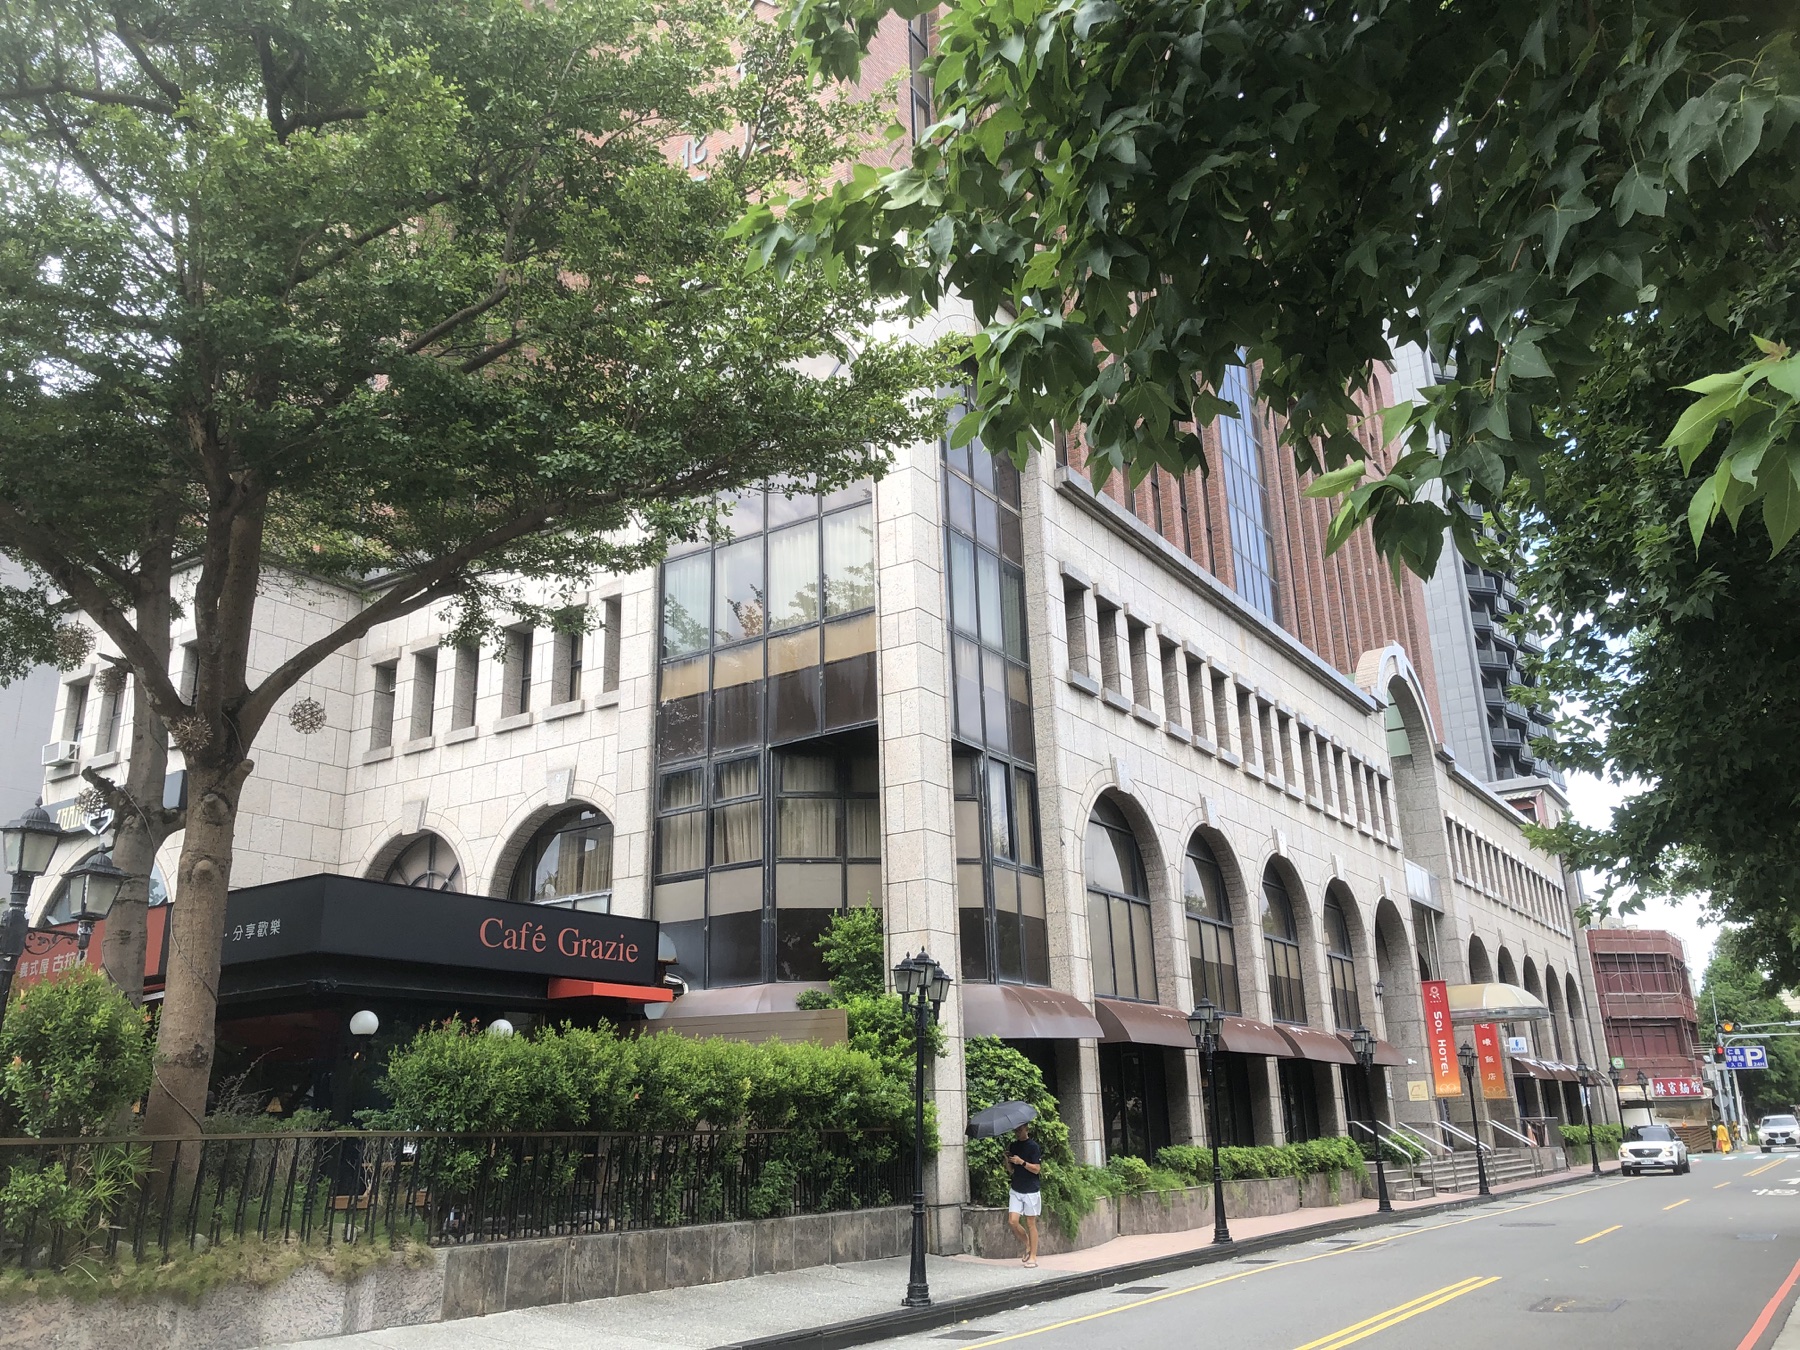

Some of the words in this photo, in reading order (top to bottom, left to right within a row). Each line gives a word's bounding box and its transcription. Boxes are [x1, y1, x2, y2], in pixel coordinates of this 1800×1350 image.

[232, 918, 281, 942] 分享歡樂
[480, 917, 547, 953] Café
[557, 927, 639, 963] Grazie
[1433, 1011, 1443, 1034] SOL
[1437, 1039, 1449, 1077] HOTEL
[1745, 1048, 1763, 1067] P
